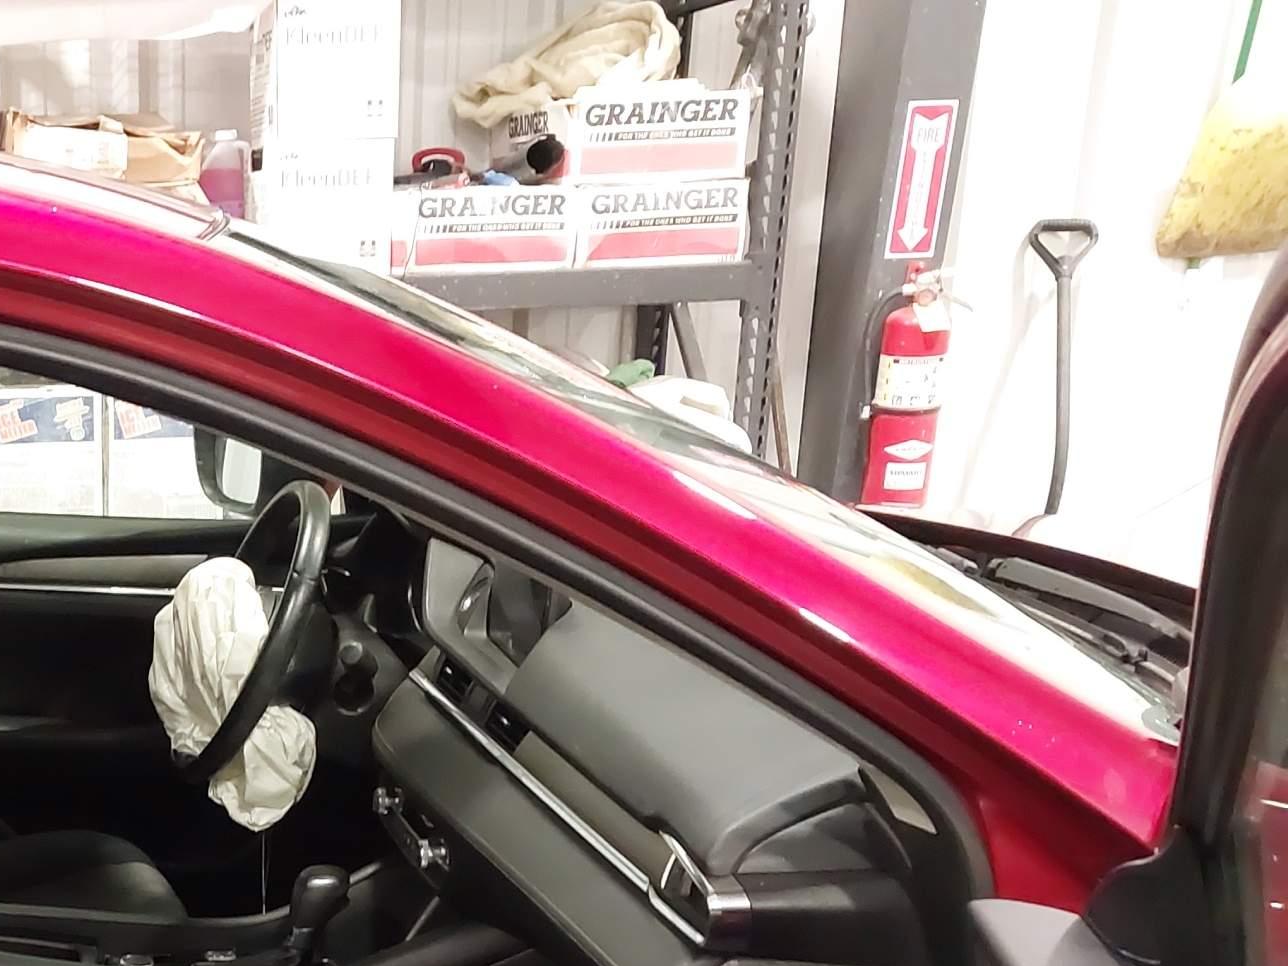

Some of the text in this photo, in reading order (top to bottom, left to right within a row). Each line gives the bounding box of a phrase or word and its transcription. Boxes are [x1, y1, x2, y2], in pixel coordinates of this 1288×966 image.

[508, 111, 549, 138] GRAINGER
[585, 98, 739, 127] GRAINGER
[916, 127, 941, 143] FIRE
[591, 187, 738, 214] GRAINGER
